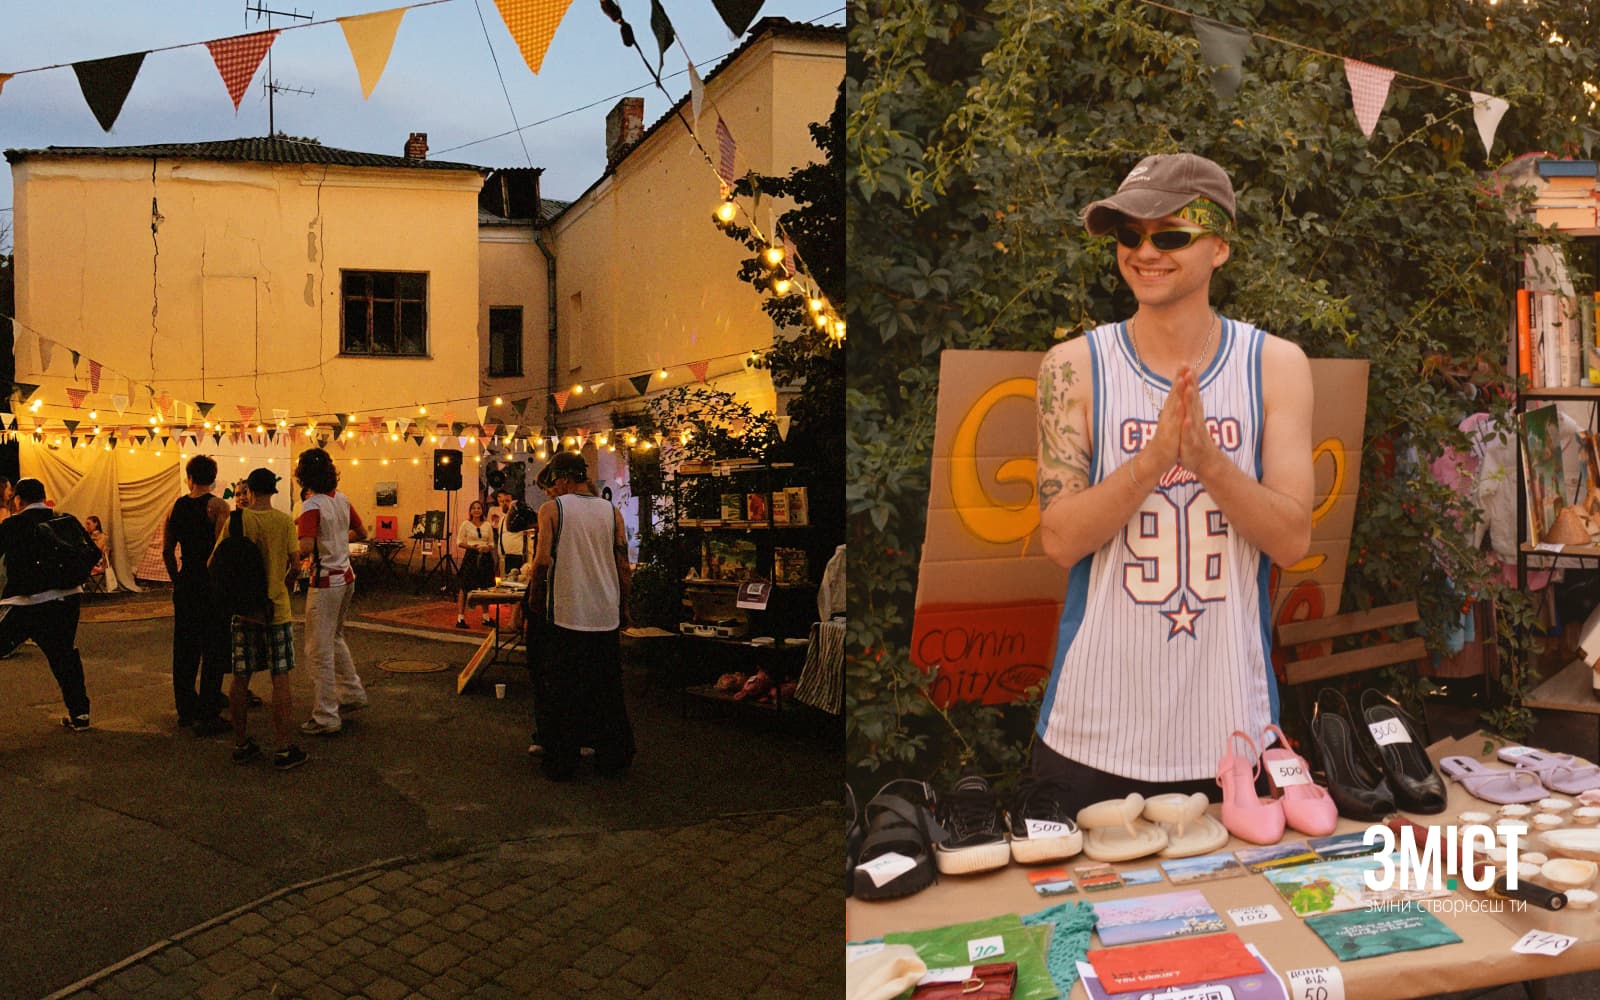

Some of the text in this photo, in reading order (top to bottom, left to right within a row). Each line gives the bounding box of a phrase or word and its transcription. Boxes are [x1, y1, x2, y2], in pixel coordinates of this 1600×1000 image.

[1120, 417, 1242, 454] CHGO
[1123, 489, 1229, 605] 96
[1279, 767, 1303, 777] 500
[1032, 823, 1062, 833] 500
[1305, 986, 1329, 1000] 50
